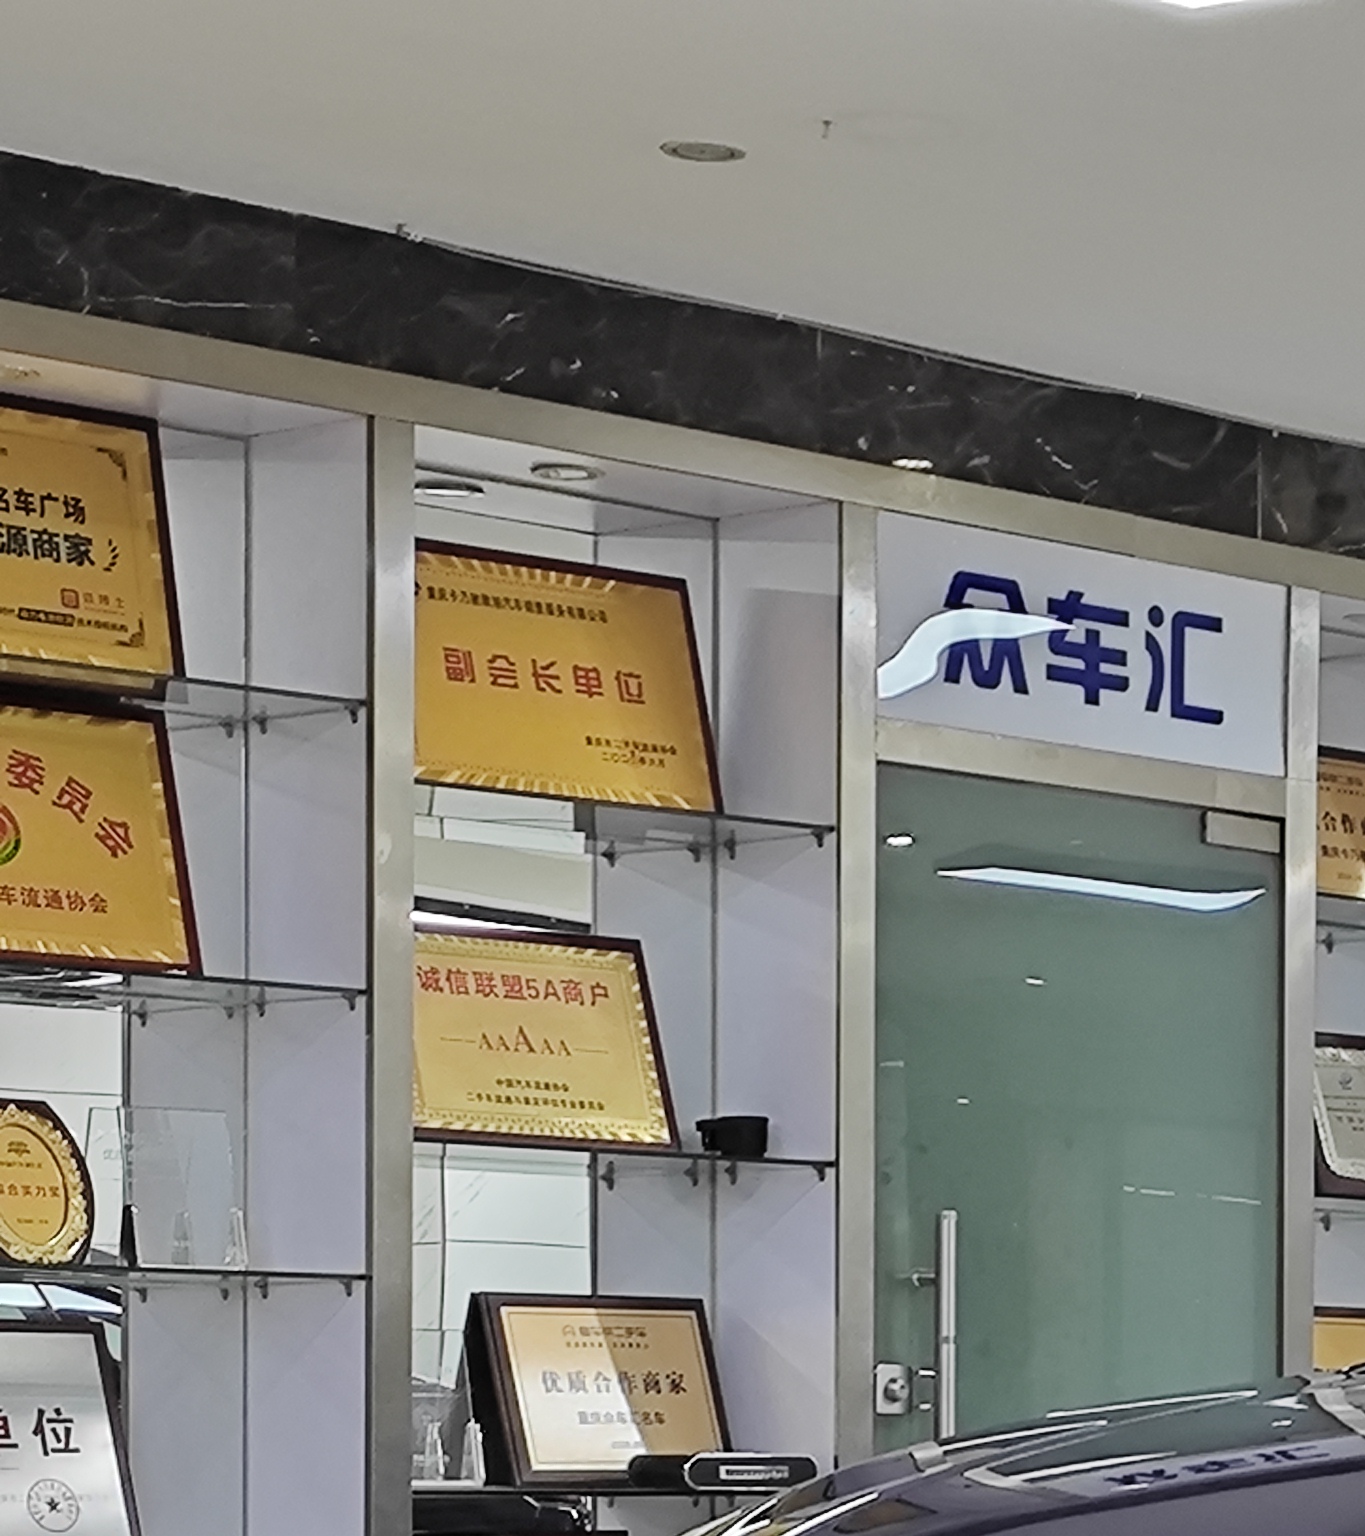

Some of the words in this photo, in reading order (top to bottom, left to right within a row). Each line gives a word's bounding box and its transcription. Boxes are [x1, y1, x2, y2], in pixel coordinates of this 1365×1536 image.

[442, 646, 646, 704] 副会长单位
[6, 748, 134, 858] 委员会
[416, 965, 610, 1006] 诚信联盟5A商户
[0, 1183, 60, 1198] 合实力奖
[541, 1370, 687, 1395] 优质合作商家
